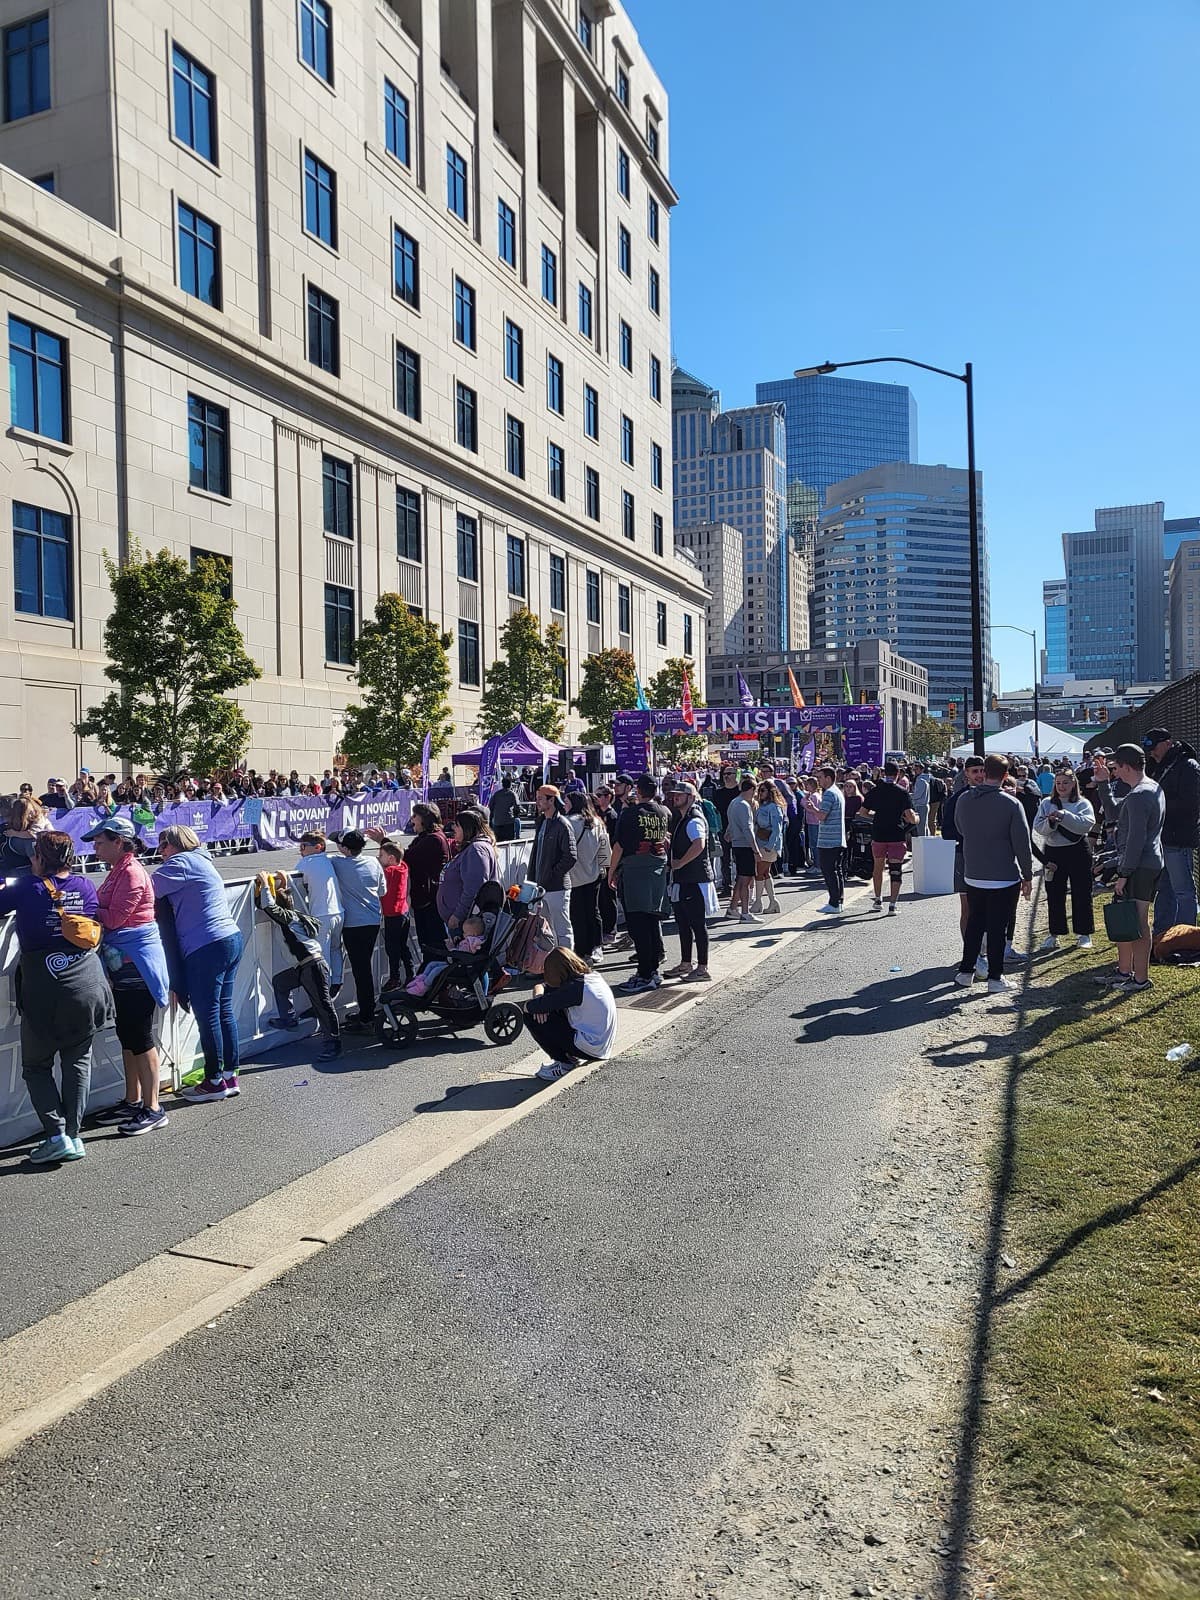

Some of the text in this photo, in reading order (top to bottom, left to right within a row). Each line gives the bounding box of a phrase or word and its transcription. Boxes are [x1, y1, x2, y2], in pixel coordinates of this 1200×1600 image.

[693, 711, 790, 732] FINISH
[289, 807, 331, 821] NOVANT
[366, 801, 400, 815] NOVANT
[366, 814, 397, 828] HEALTH
[290, 820, 327, 837] HEALTH
